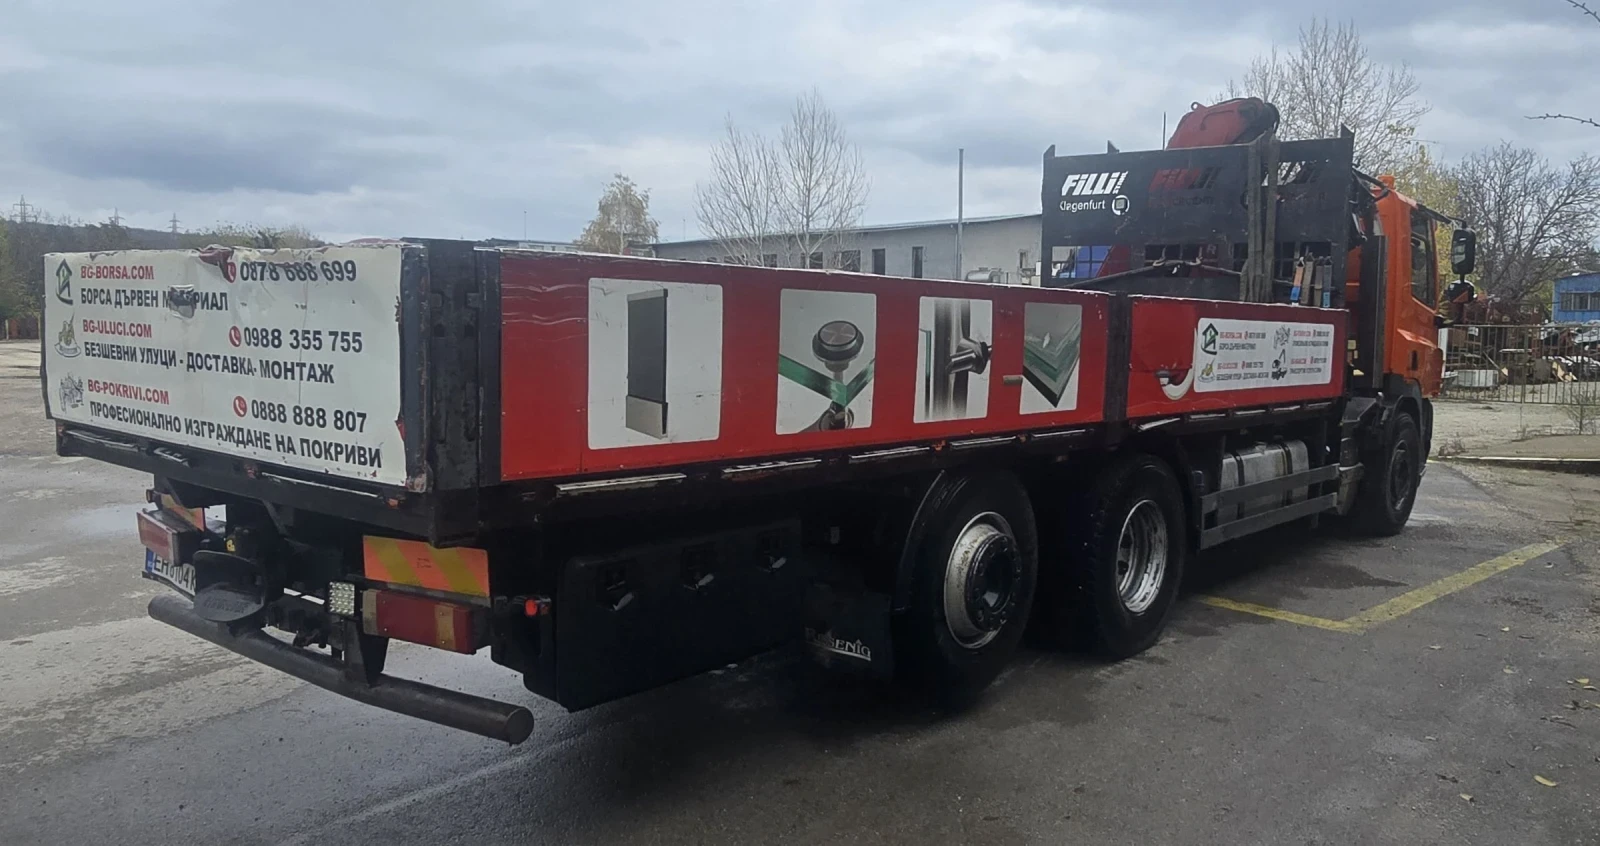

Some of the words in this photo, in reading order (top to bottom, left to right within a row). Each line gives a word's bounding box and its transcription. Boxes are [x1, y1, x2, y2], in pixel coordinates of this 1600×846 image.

[80, 265, 155, 280] BG-BORSA.COM
[240, 261, 280, 281] 0878
[320, 260, 357, 282] 699
[80, 288, 113, 306] БОРСА
[114, 289, 159, 309] ДЪРВЕН
[162, 290, 229, 311] МРИАЛ
[82, 319, 153, 338] BG-ULUCI.COM
[243, 326, 283, 349] 0988
[289, 329, 323, 351] 355
[328, 331, 363, 353] 755
[84, 341, 138, 363] БЕЗШЕВНИ
[139, 347, 177, 369] УЛУЦИ
[259, 359, 335, 384] МОНТАЖ
[87, 378, 170, 405] BG-POKRIVI.COM
[251, 399, 287, 424] 0888
[292, 405, 327, 429] 888
[333, 409, 367, 433] 807
[89, 400, 182, 433] ПРОФЕСИОНАЛНО
[184, 417, 272, 451] ИЗГРАЖДАНЕ
[275, 433, 297, 456] НА
[299, 437, 382, 469] ПОКРИВИ
